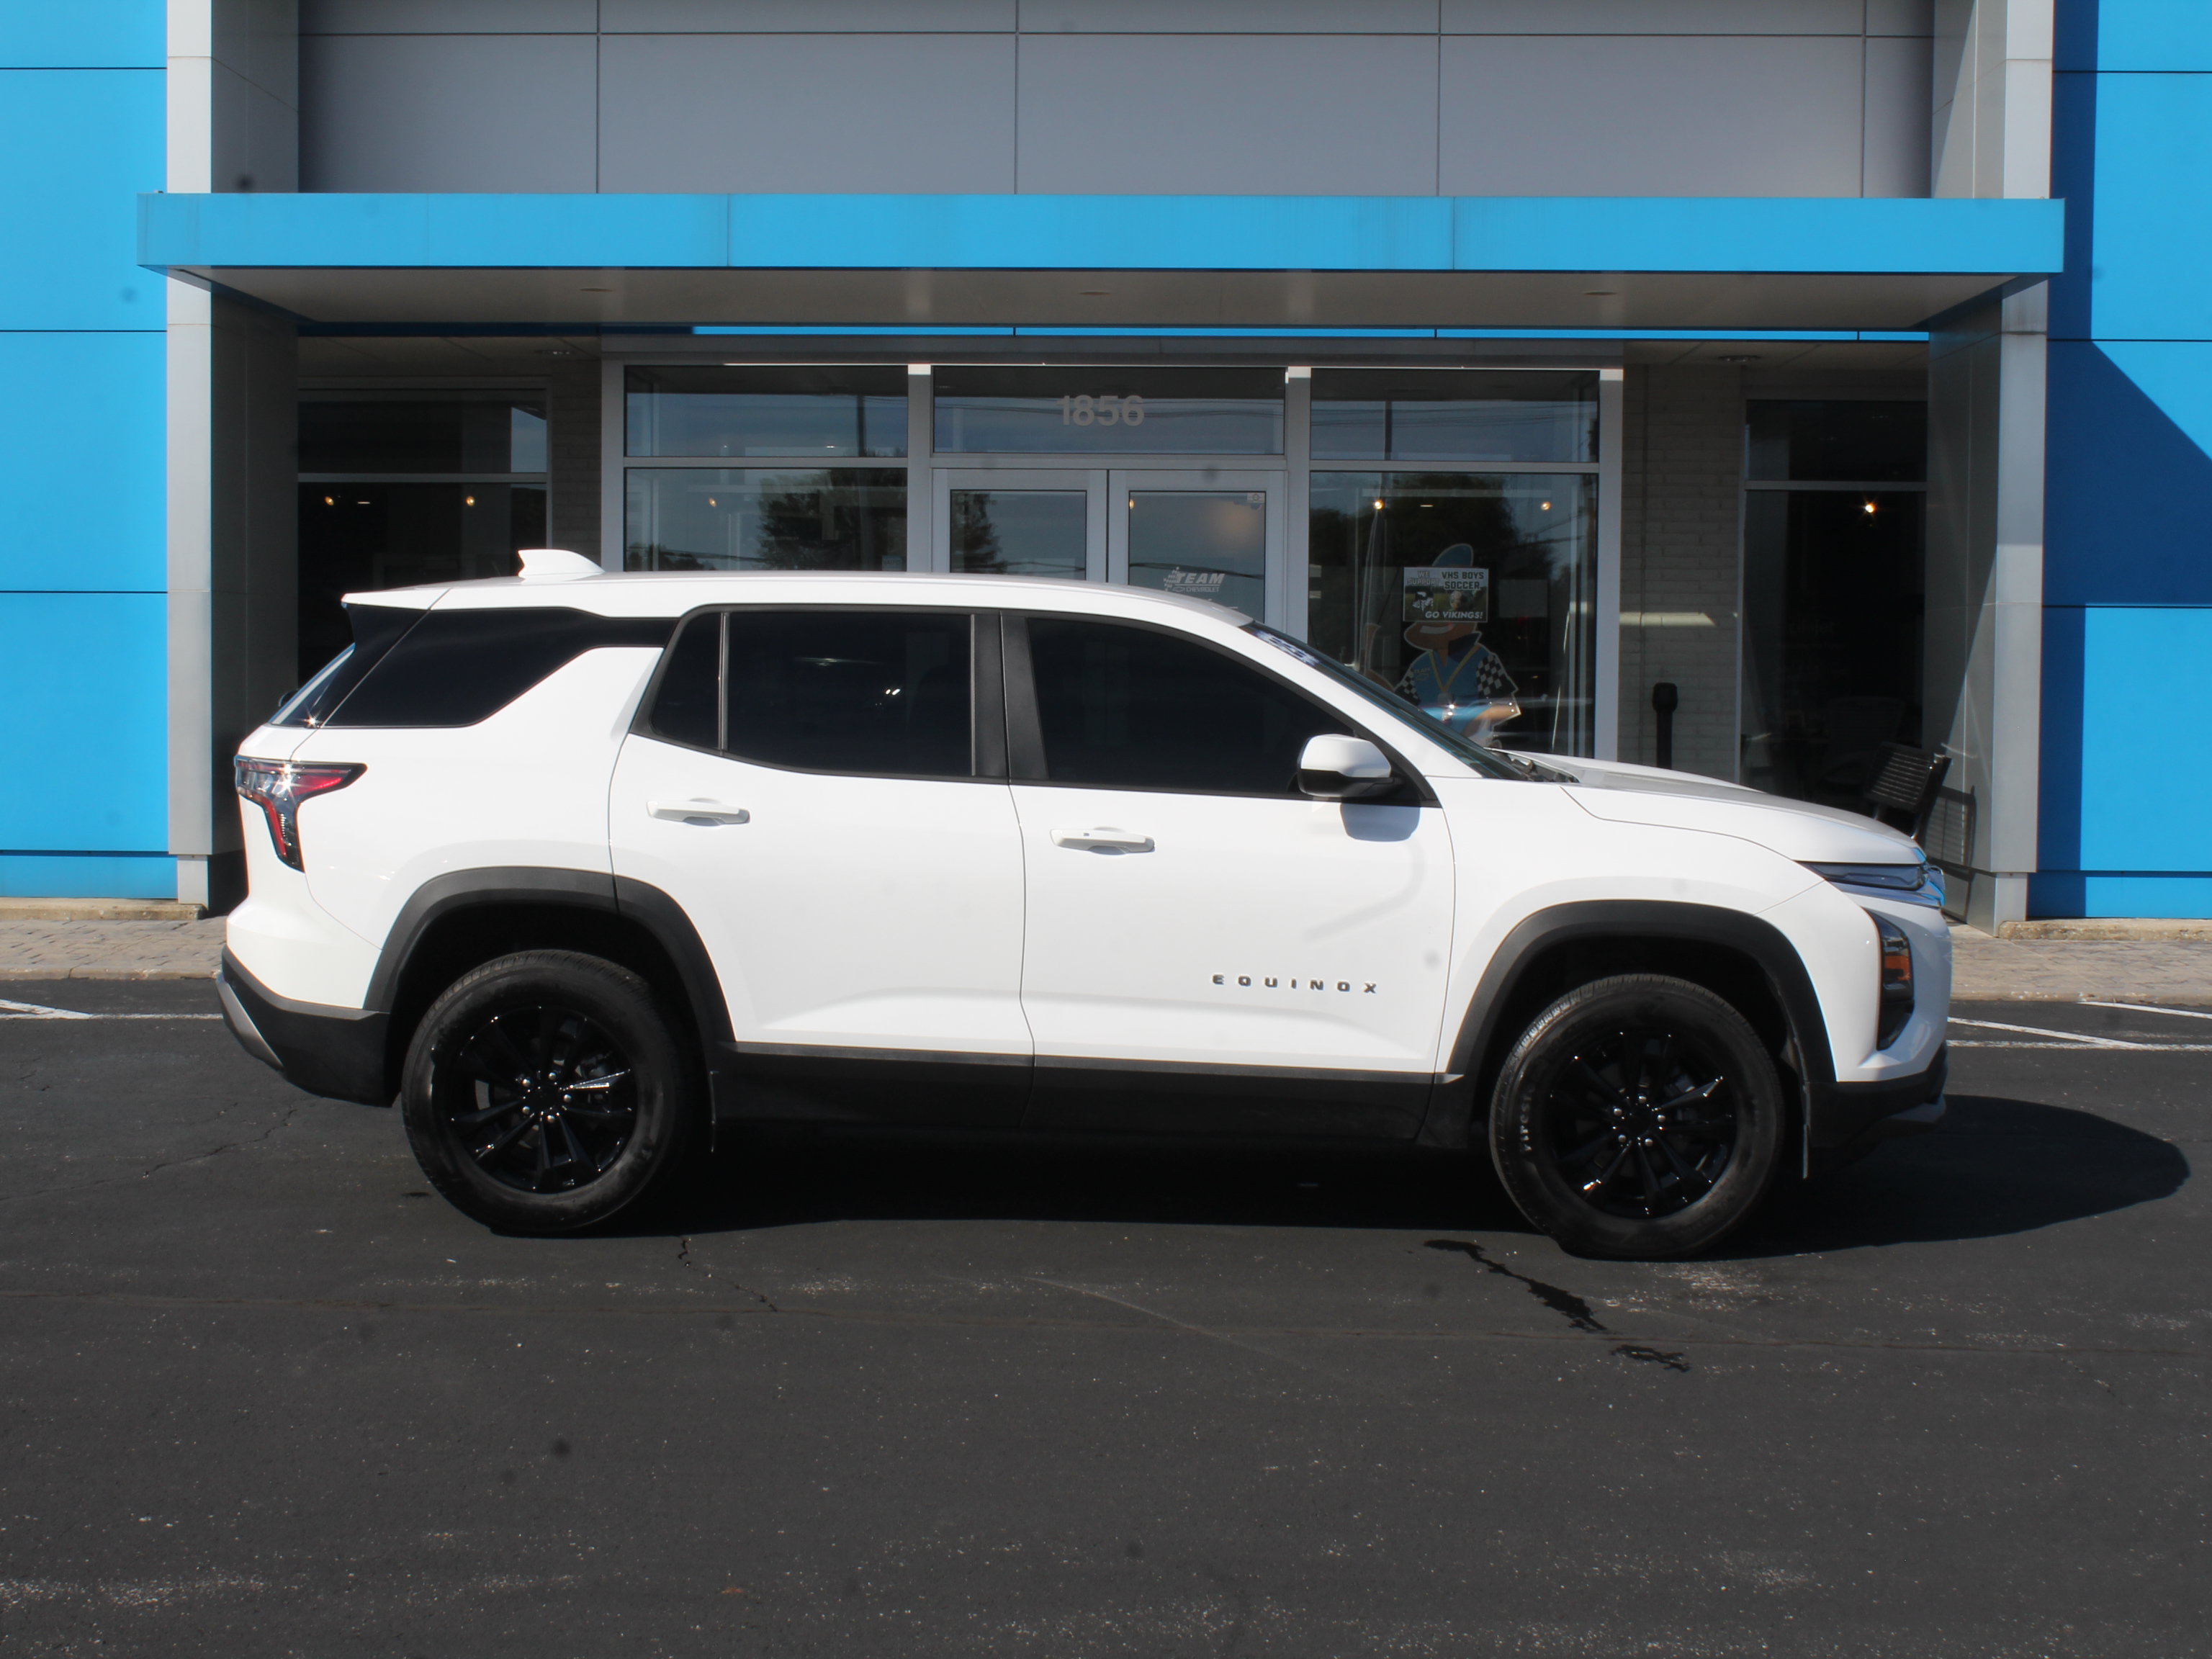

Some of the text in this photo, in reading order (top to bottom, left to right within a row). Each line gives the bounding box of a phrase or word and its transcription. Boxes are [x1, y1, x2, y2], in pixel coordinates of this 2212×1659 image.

[1057, 395, 1145, 427] 1856
[1174, 572, 1225, 584] TEAM
[1442, 571, 1459, 580] VHS
[1444, 581, 1480, 590] SOCCER
[1442, 611, 1483, 619] VIKINGS!
[1213, 974, 1377, 994] EQUINOX
